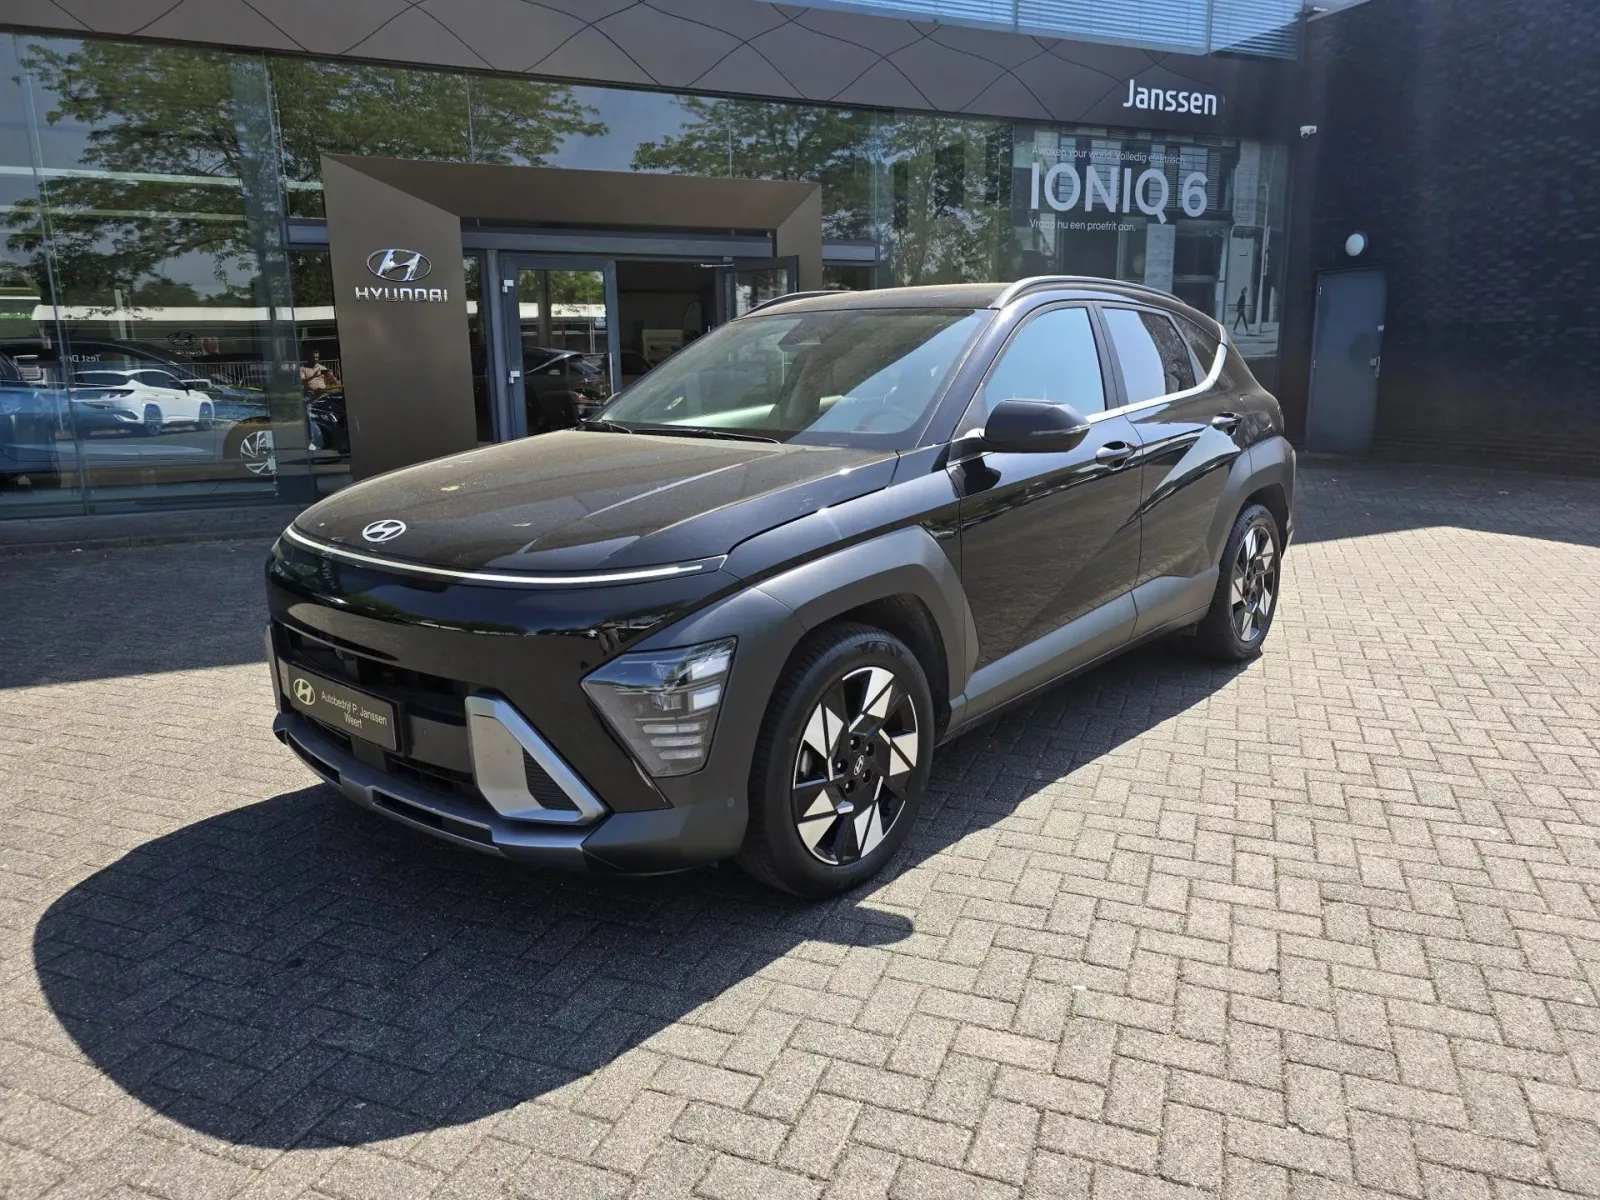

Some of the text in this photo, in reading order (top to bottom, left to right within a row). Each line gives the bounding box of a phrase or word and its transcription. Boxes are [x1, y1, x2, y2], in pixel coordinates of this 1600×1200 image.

[1122, 78, 1217, 116] Janssen
[1031, 144, 1067, 158] Awaken
[1067, 147, 1087, 160] your
[1115, 149, 1147, 164] Volledig
[1030, 162, 1209, 224] IONIQ 6
[1057, 220, 1069, 230] nu
[1069, 221, 1086, 231] een
[1087, 220, 1117, 232] proefrit
[1117, 223, 1136, 232] aan.
[355, 286, 449, 302] HYUNDAI
[321, 690, 351, 714] Autobedrijf
[360, 706, 388, 727] Janssen
[343, 711, 363, 730] Weert
